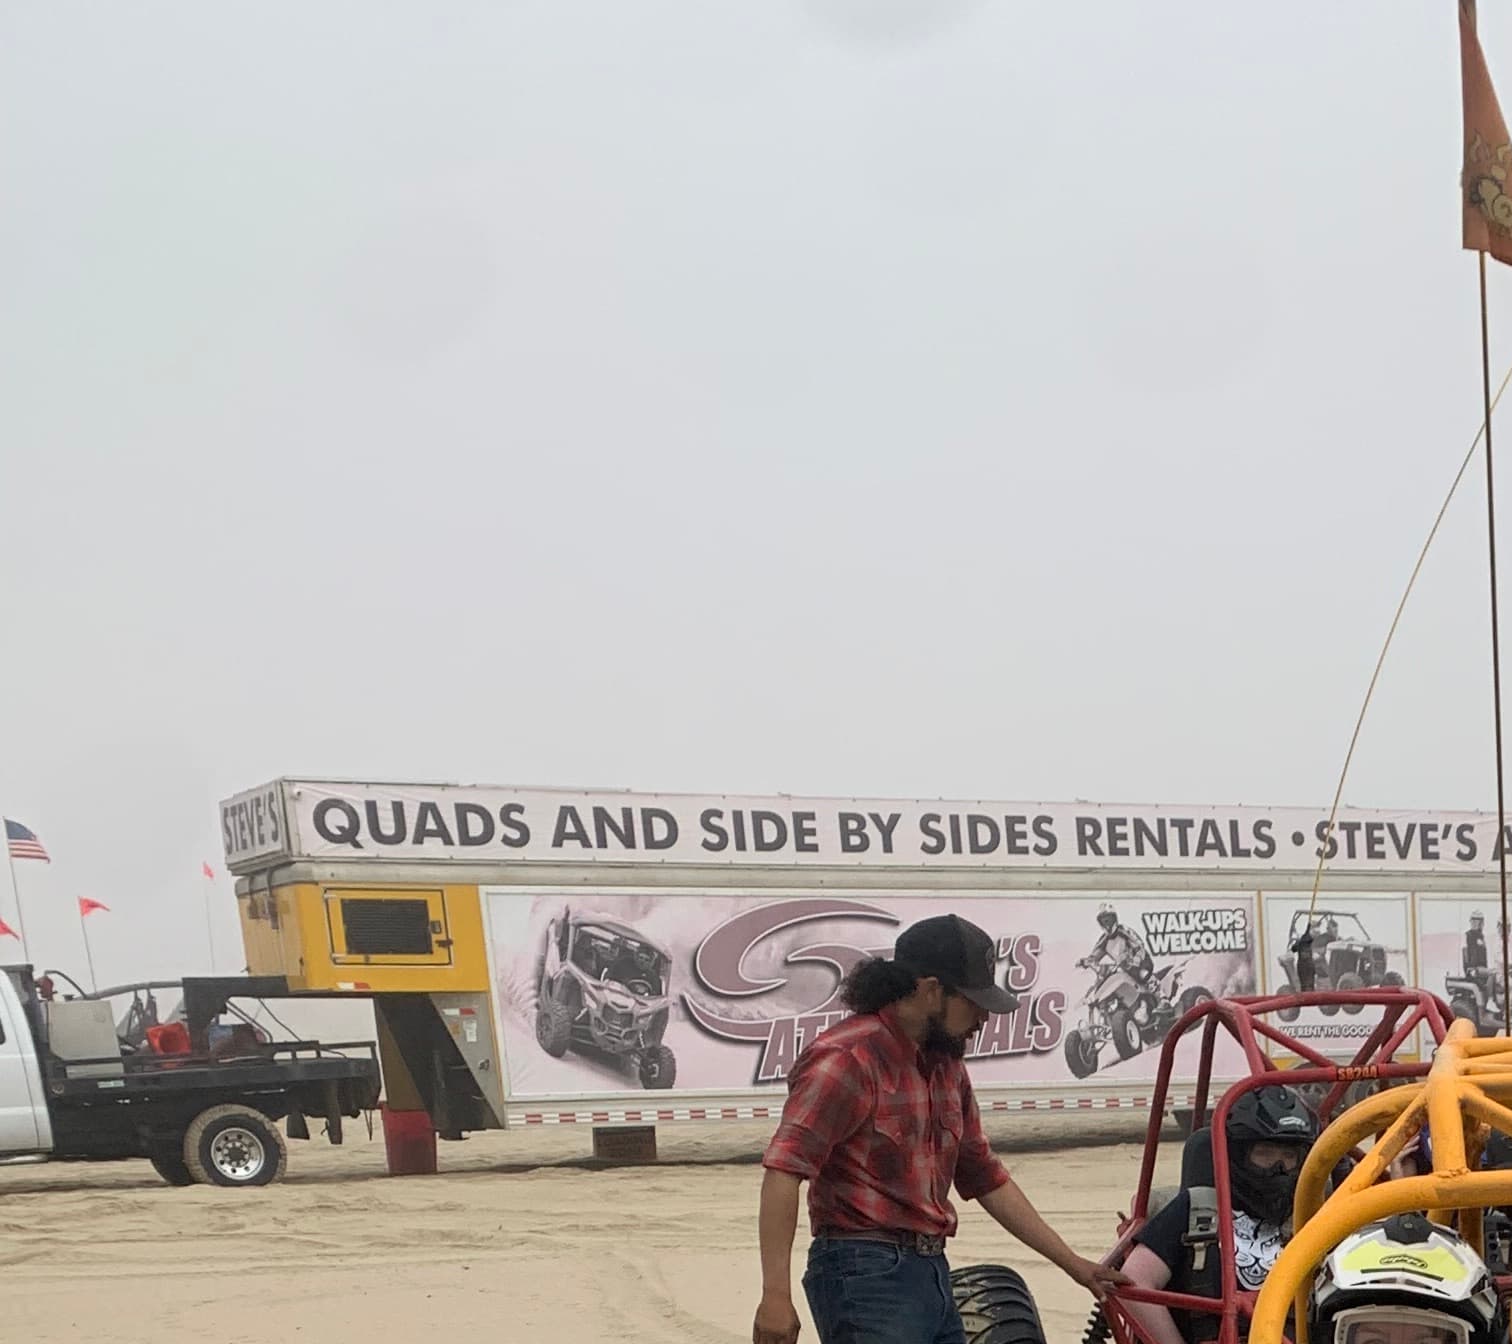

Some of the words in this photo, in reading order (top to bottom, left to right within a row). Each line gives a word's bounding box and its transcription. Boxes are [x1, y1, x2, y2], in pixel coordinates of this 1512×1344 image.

[224, 791, 278, 855] STEVE'S
[313, 797, 531, 849] QUADS
[551, 805, 679, 850] AND
[700, 808, 819, 852] SIDE
[838, 811, 902, 854] BY
[919, 813, 1058, 856] SIDES
[1075, 816, 1276, 859] RENTALS
[1315, 820, 1477, 862] STEVE'S
[1143, 909, 1246, 933] WALK-UPS
[1148, 930, 1246, 954] WELCOME
